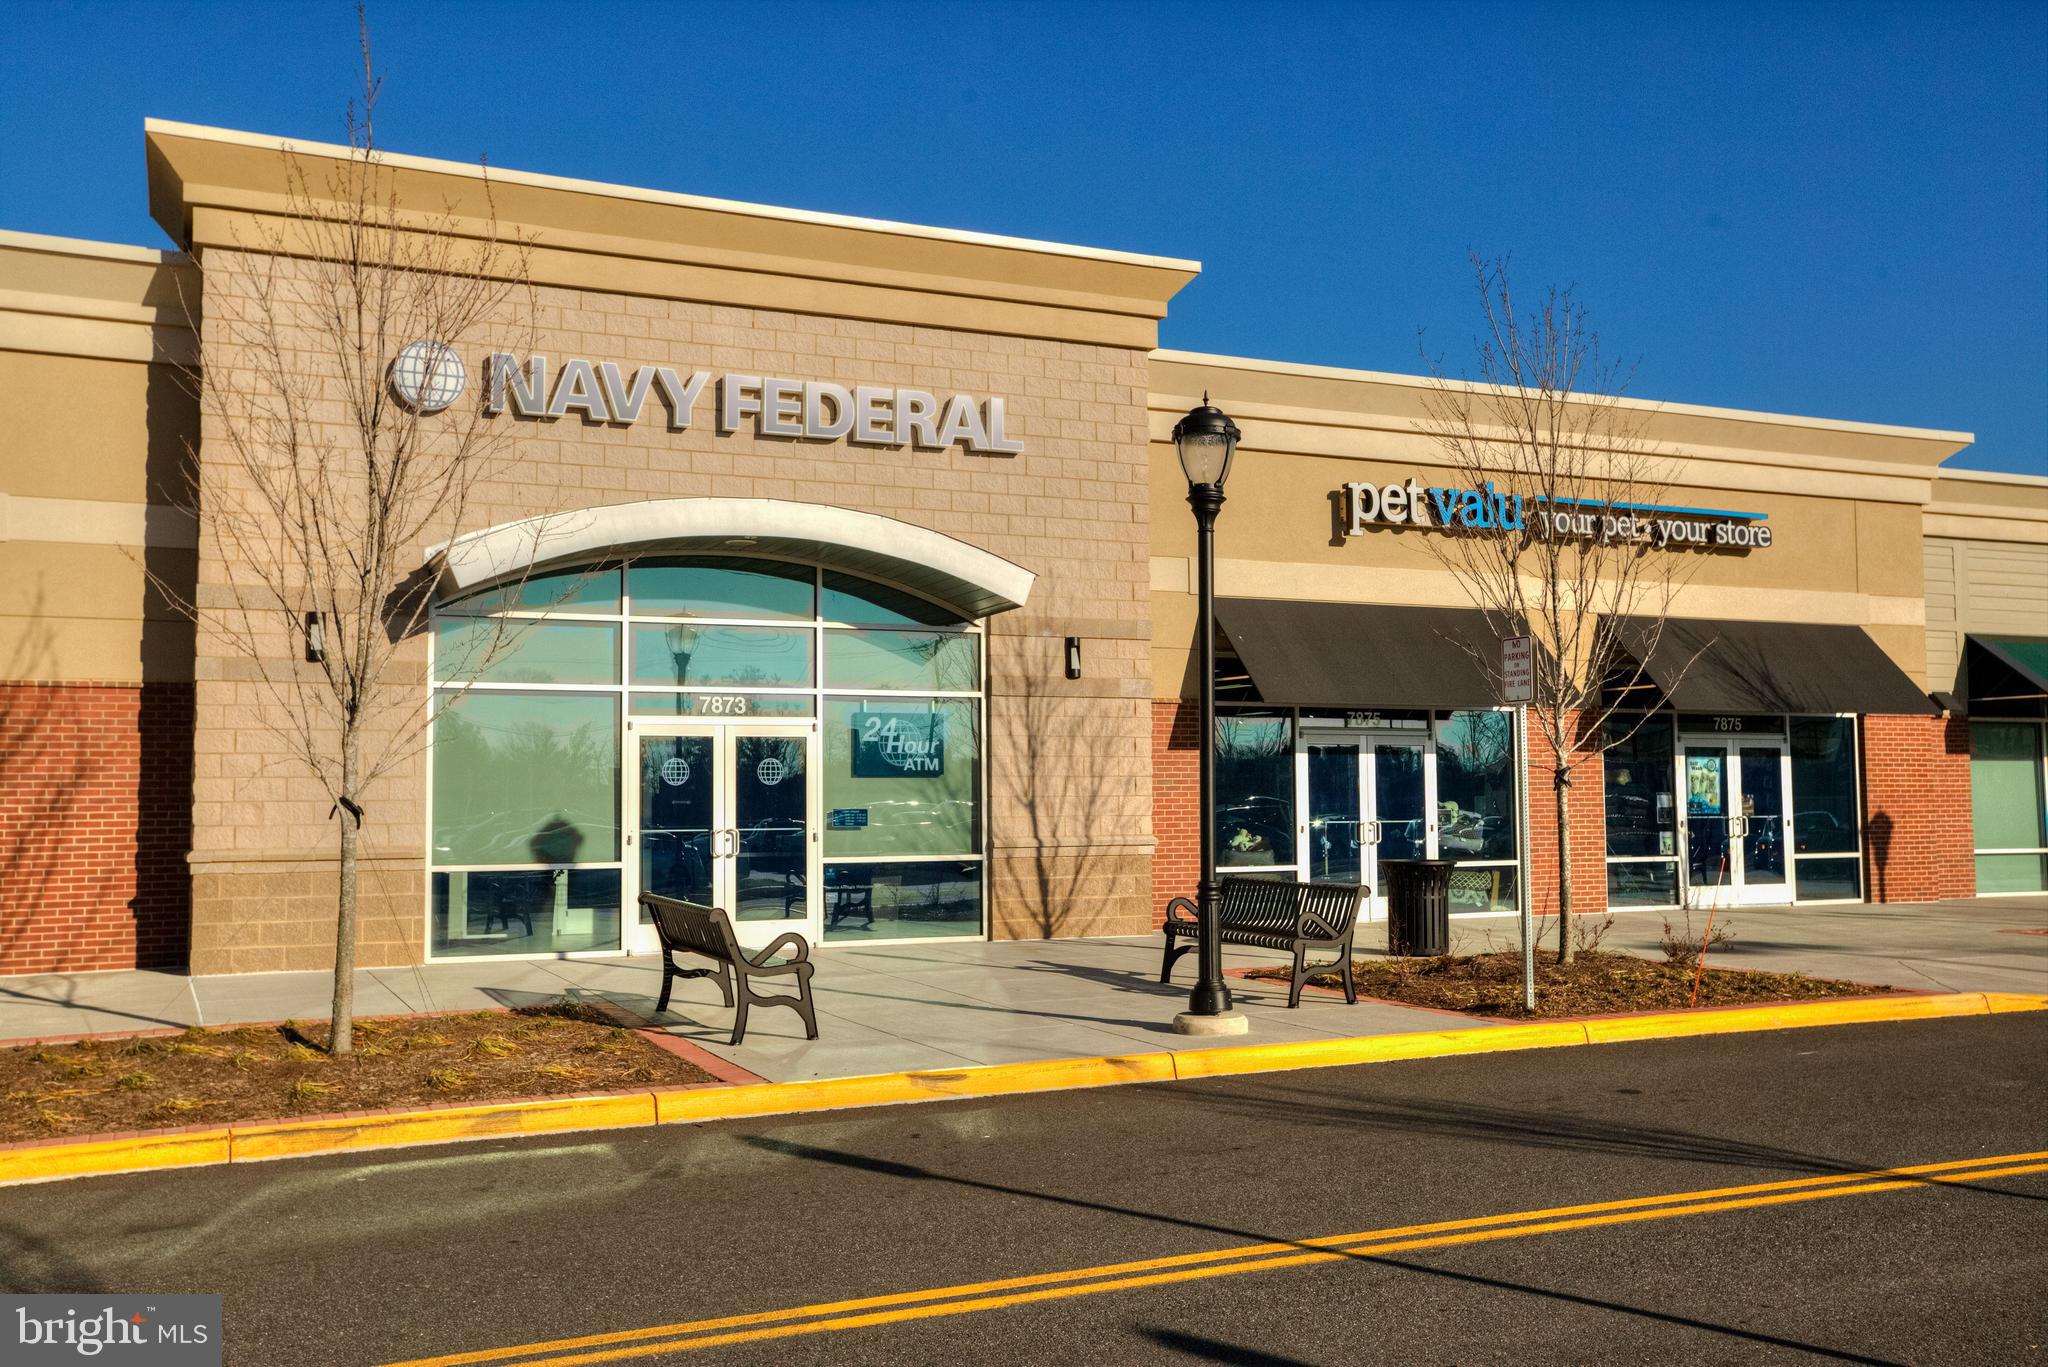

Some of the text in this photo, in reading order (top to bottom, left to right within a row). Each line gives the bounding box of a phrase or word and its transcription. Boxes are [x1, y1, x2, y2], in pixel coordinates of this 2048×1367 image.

[488, 351, 1025, 453] NAVY FEDERAL
[1348, 477, 1525, 537] pet valu
[1538, 510, 1771, 547] your pet your store
[1512, 640, 1521, 649] NO
[1504, 651, 1530, 661] PARKING
[1504, 669, 1530, 678] STANDING
[699, 696, 746, 715] 7873
[1347, 711, 1381, 726] 7875
[1713, 716, 1742, 732] 7875
[862, 716, 898, 742] 24
[886, 734, 940, 755] Hour
[903, 757, 939, 771] ATM
